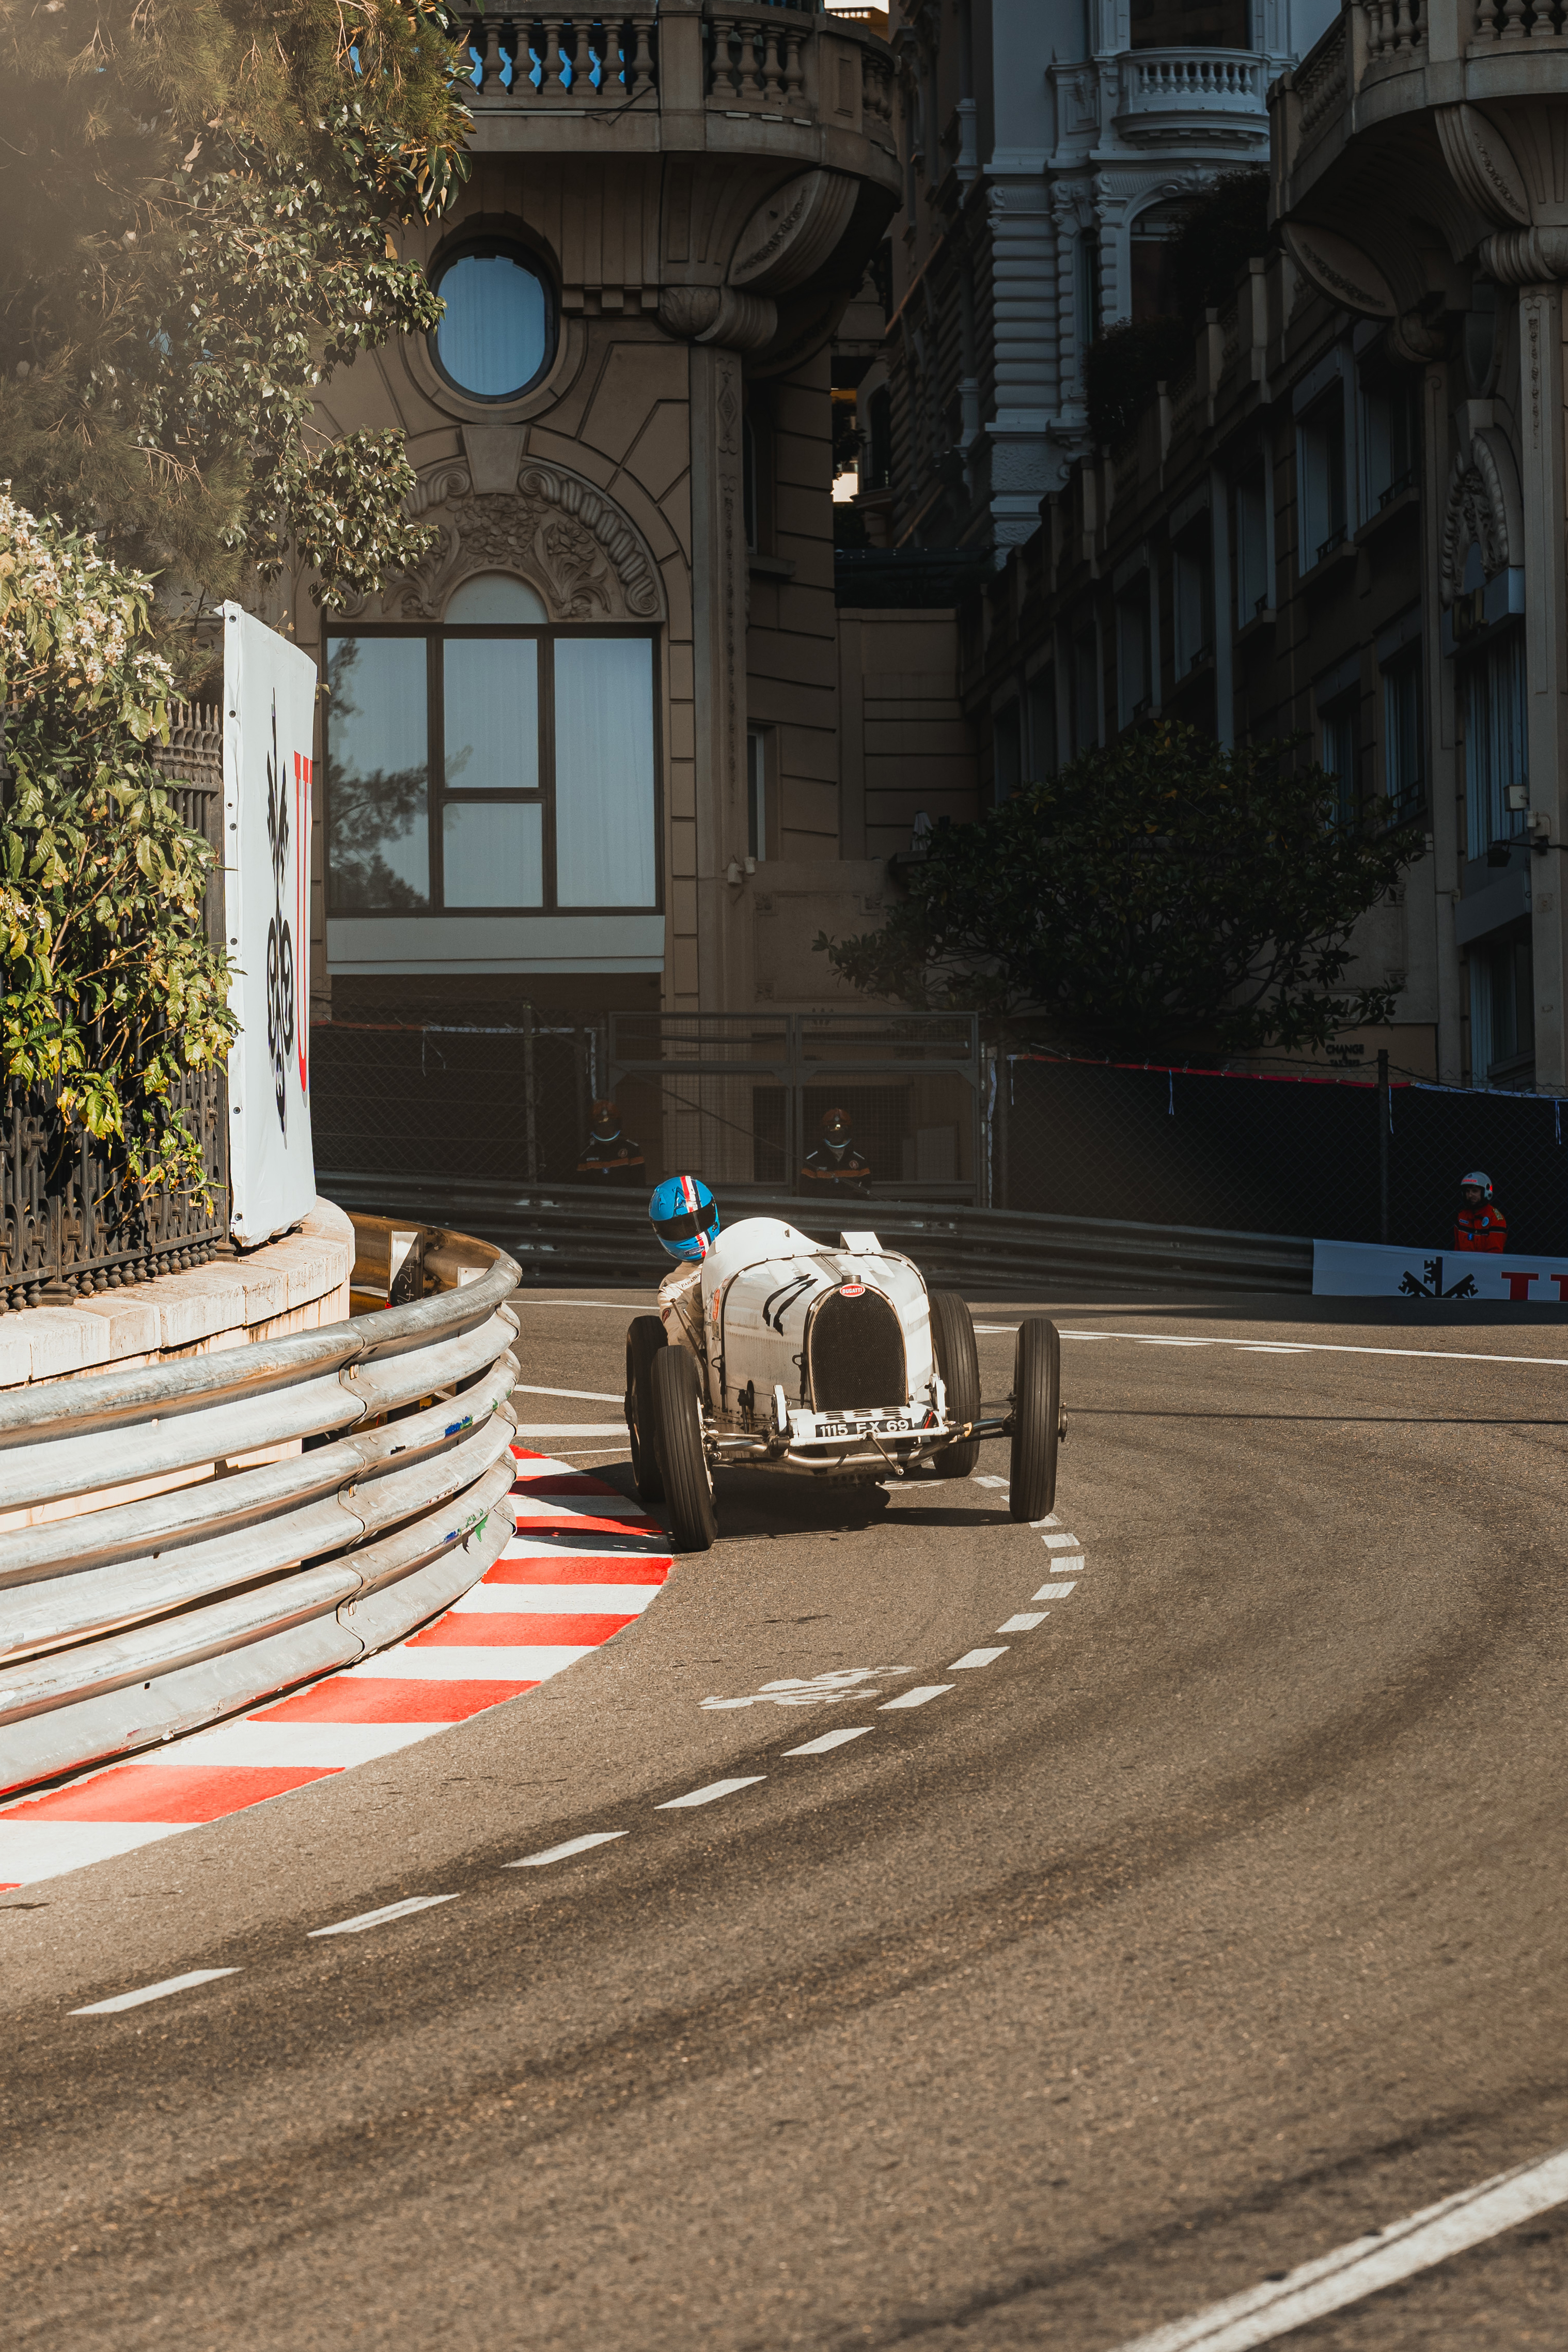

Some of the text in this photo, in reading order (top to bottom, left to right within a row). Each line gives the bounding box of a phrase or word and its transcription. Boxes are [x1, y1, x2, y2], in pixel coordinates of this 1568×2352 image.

[1325, 1044, 1365, 1054] CHANGE
[820, 1424, 849, 1437] 1115
[886, 1419, 909, 1432] 69
